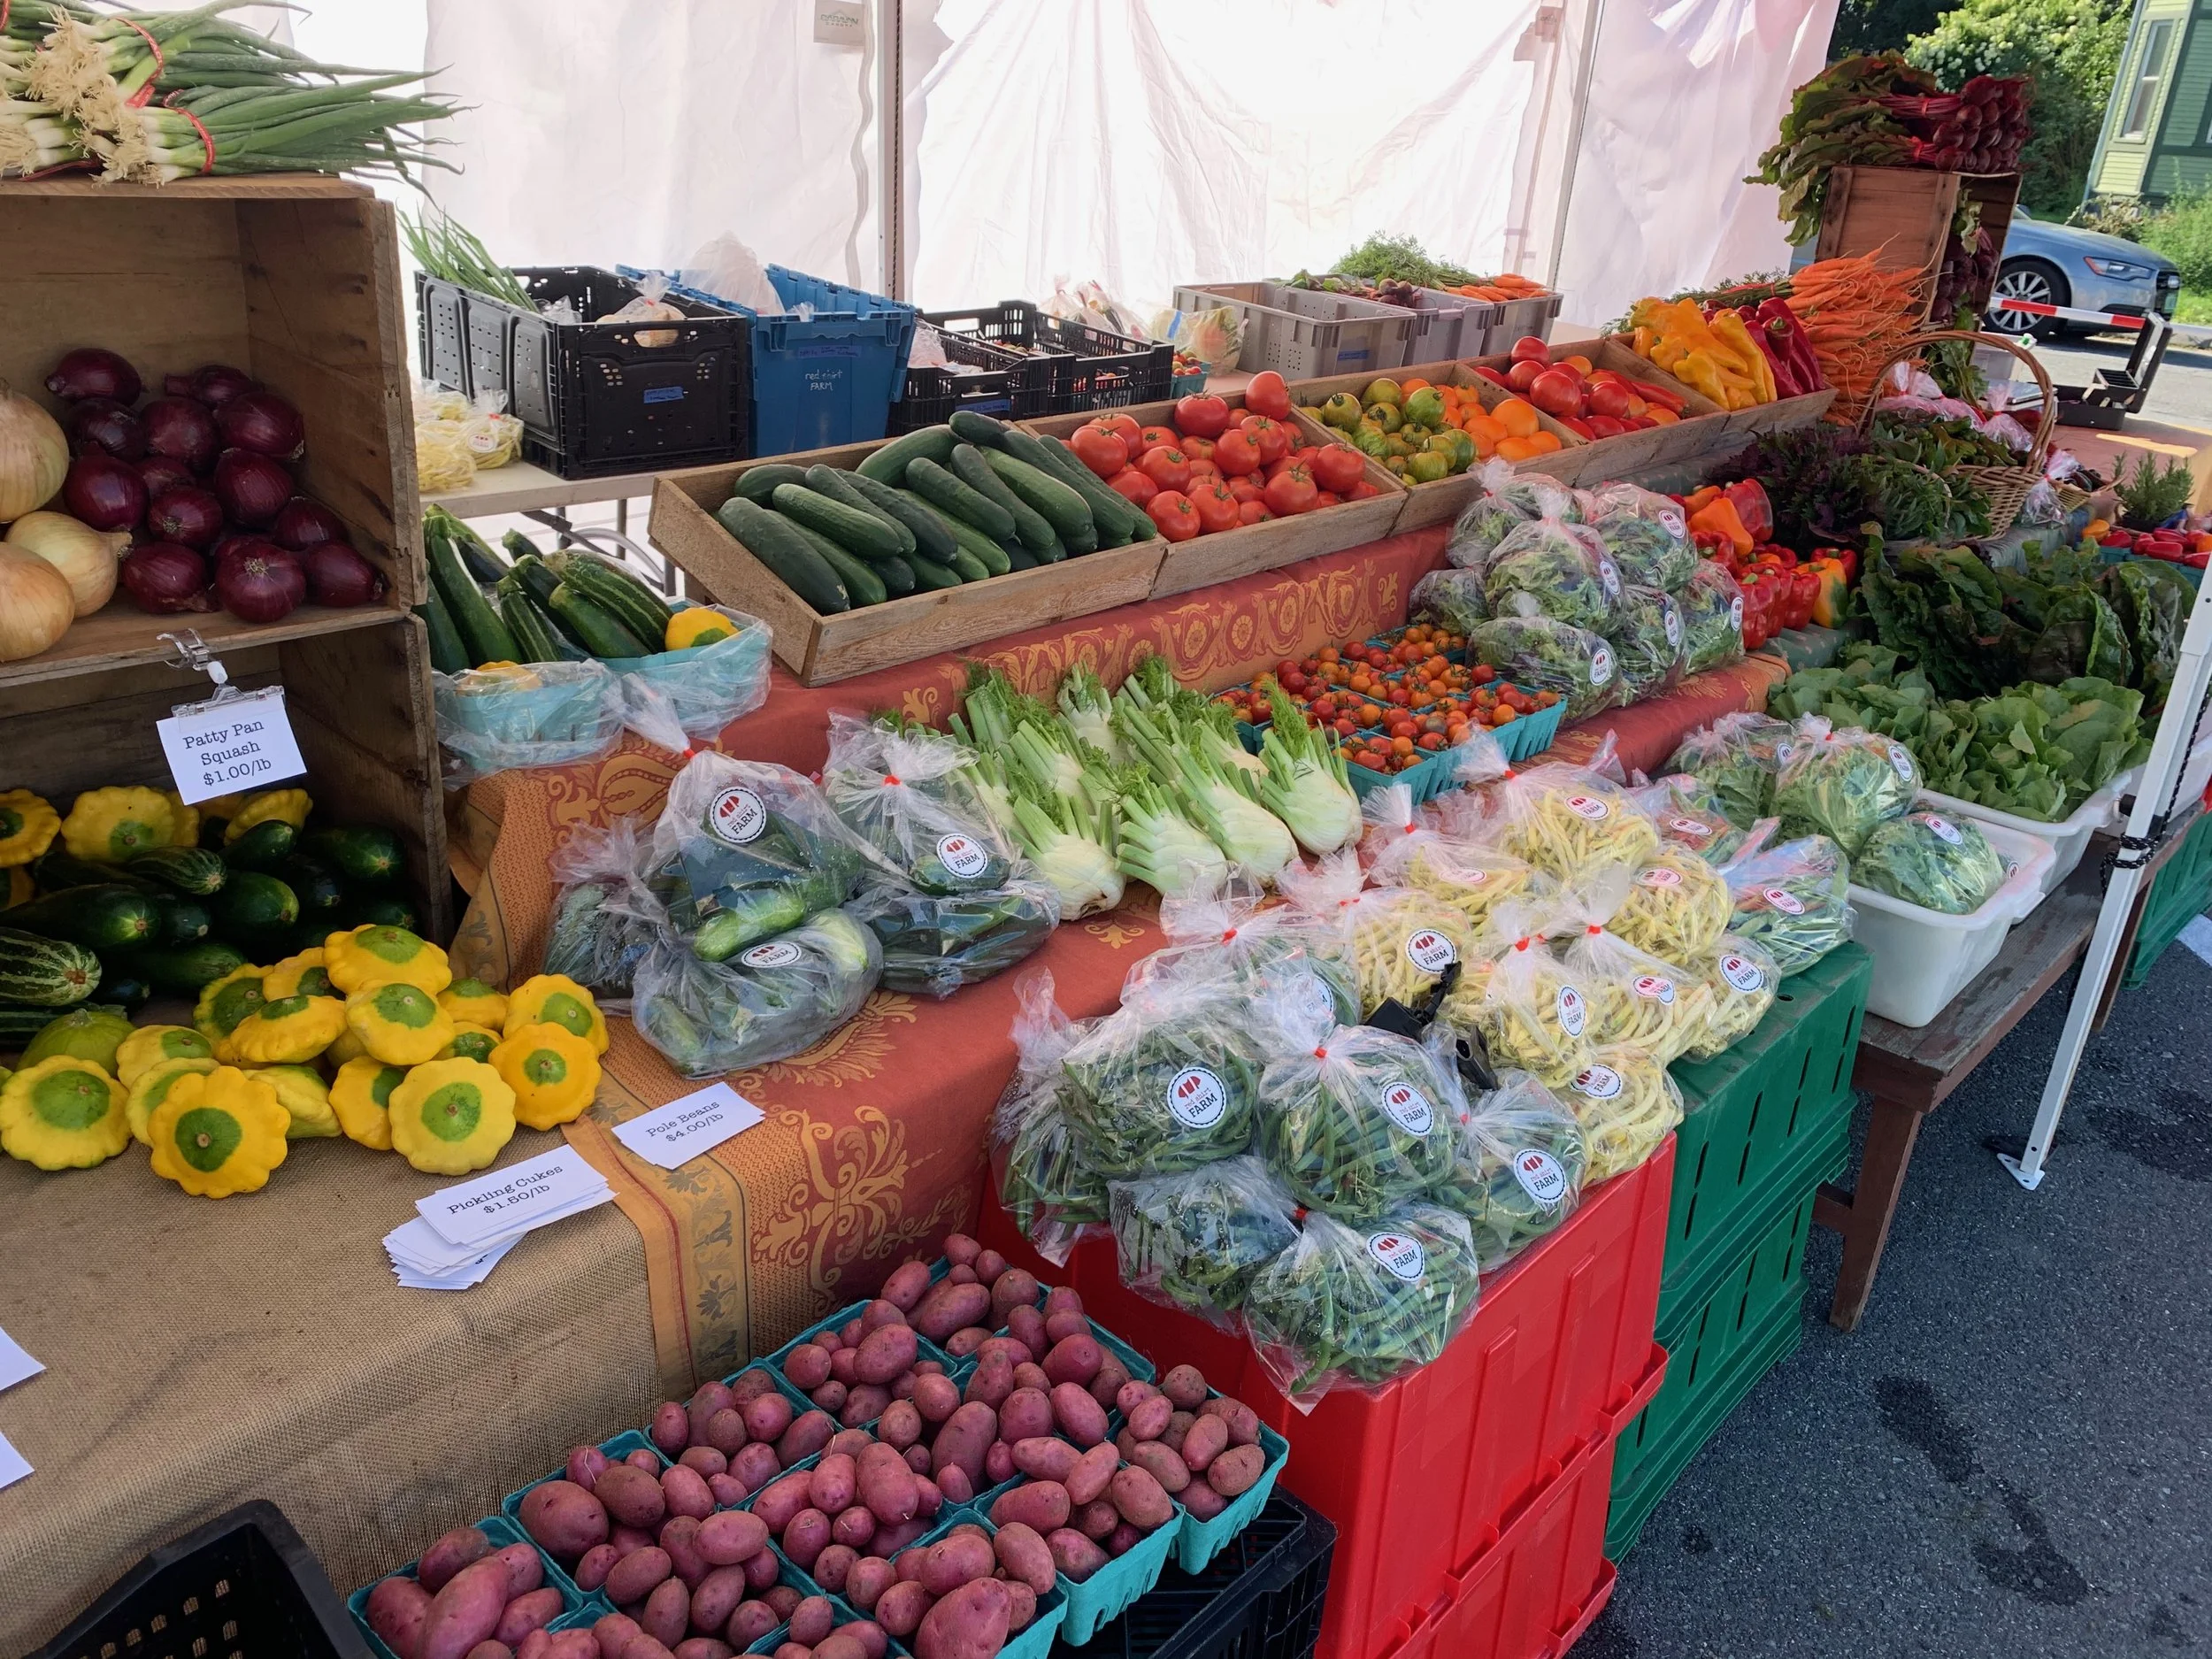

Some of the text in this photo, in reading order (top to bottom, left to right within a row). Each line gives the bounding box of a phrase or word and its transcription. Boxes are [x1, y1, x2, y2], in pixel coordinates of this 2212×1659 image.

[805, 369, 820, 380] red
[810, 382, 833, 391] FARM
[183, 721, 265, 749] Patty Pan
[201, 741, 261, 766] Squash
[203, 758, 272, 787] $1.00/lb
[732, 809, 758, 834] FARM
[955, 853, 980, 869] FARM
[764, 950, 792, 964] FARM
[1424, 949, 1449, 965] FARM
[1738, 969, 1756, 985] FARM
[1567, 1011, 1582, 1027] FARM
[1594, 1074, 1612, 1092] FARM
[1188, 1093, 1217, 1118] FARM
[646, 1102, 720, 1137] Pole Beans
[1403, 1108, 1427, 1123] FARM
[665, 1113, 724, 1141] $4.00/lb
[446, 1165, 564, 1214] Pickling Cukes
[1533, 1173, 1559, 1191] FARM
[483, 1184, 550, 1214] $1.50/lb
[1393, 1249, 1417, 1269] FARM
